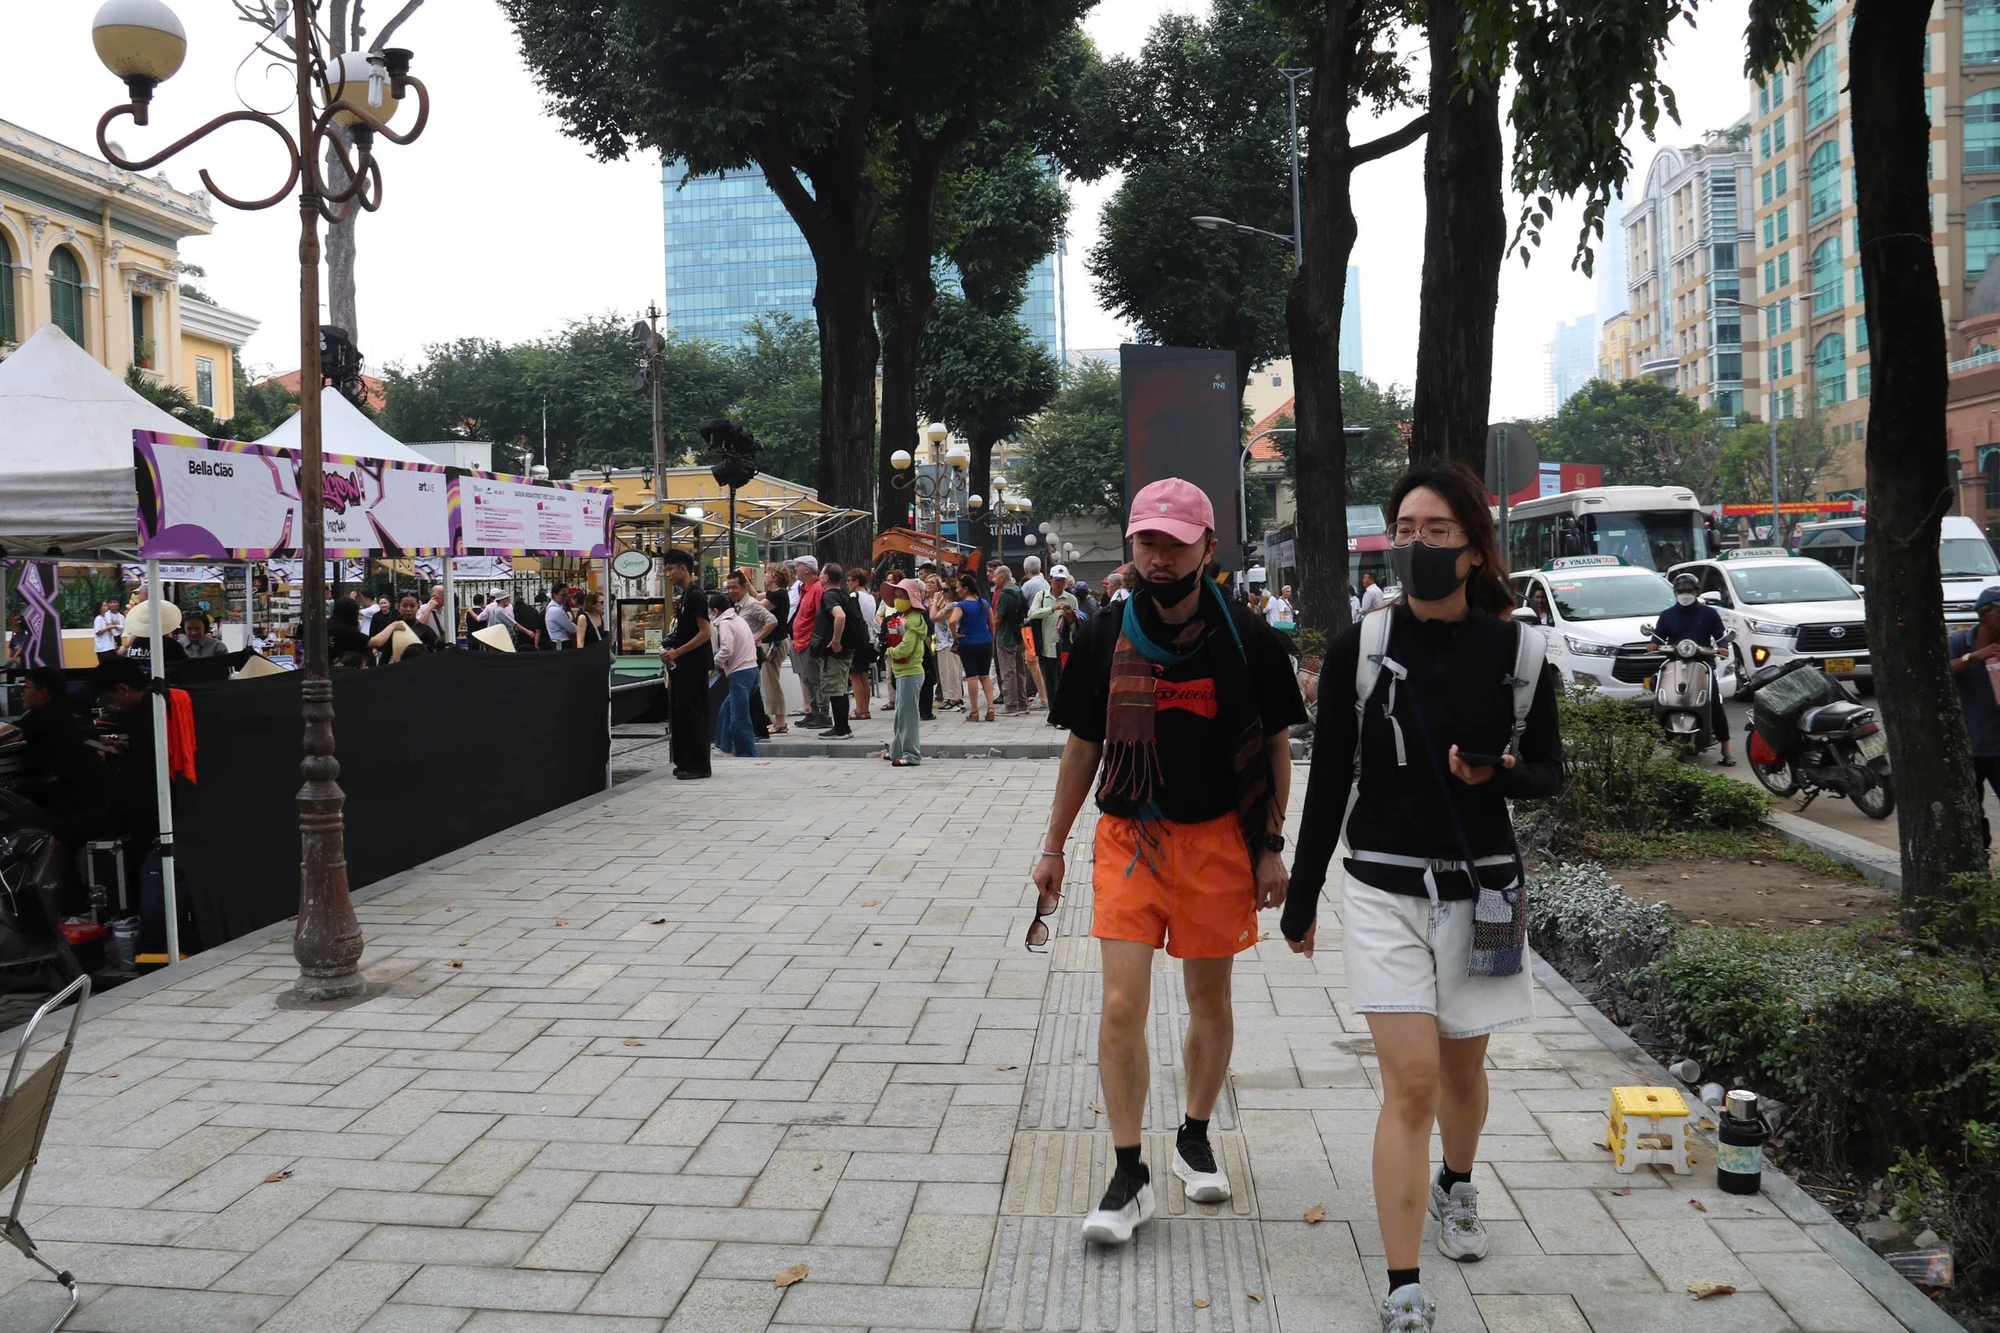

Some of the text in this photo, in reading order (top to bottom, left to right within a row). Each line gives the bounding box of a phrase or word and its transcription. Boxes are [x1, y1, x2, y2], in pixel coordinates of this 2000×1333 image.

[1212, 381, 1226, 391] PNJ
[188, 460, 234, 478] Bella Ciao
[130, 646, 152, 657] artLIV
